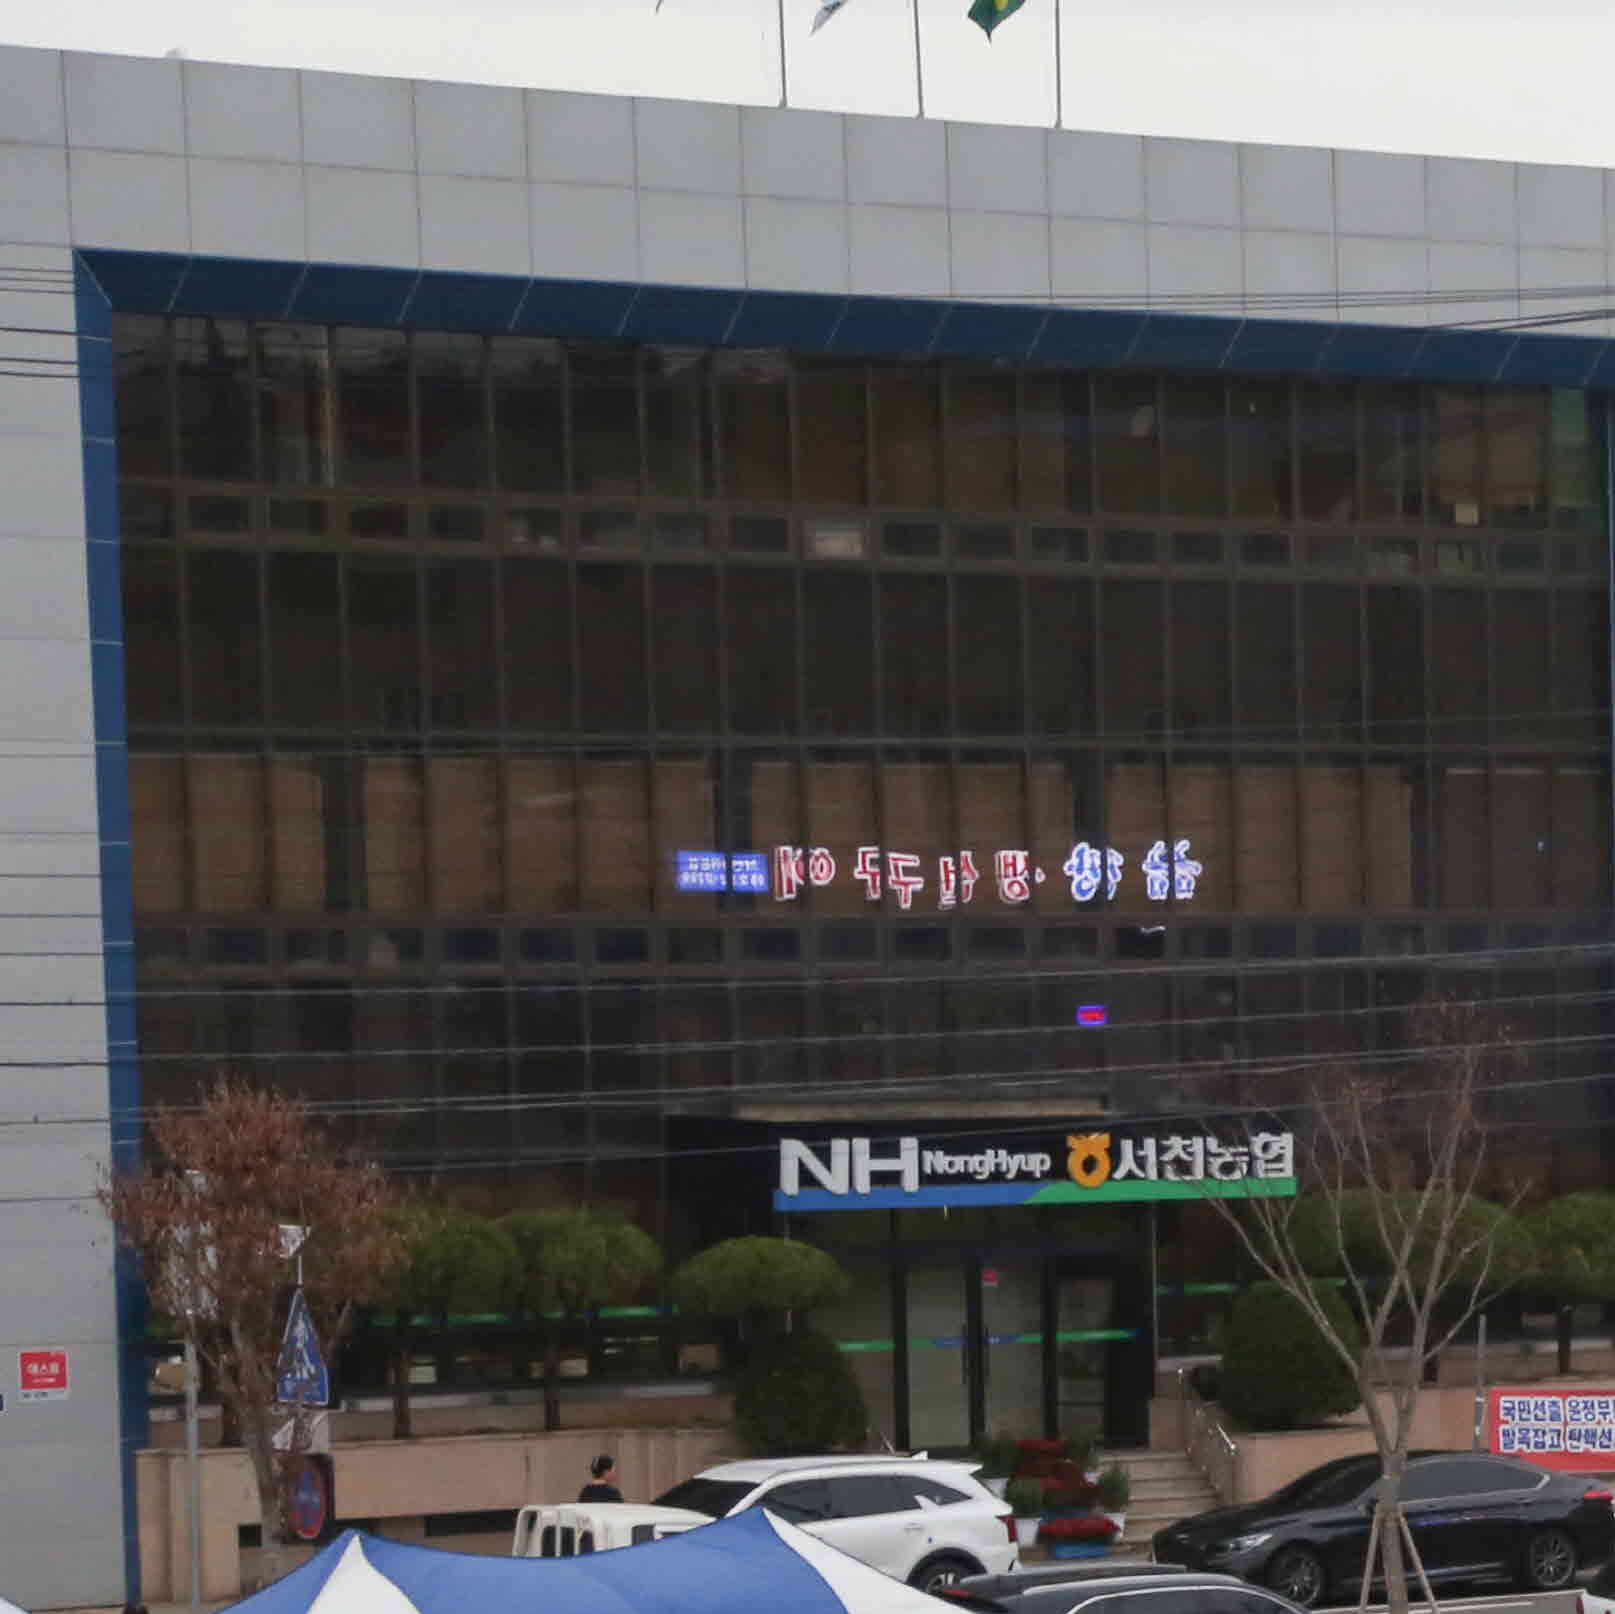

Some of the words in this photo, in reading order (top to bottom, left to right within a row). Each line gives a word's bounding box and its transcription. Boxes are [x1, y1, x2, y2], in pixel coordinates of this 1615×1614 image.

[780, 1137, 919, 1196] NH
[922, 1148, 1051, 1180] NongHyup
[1112, 1131, 1294, 1181] 서천농협
[1501, 1397, 1563, 1422] 국민선출
[1501, 1426, 1563, 1451] 발목잡고
